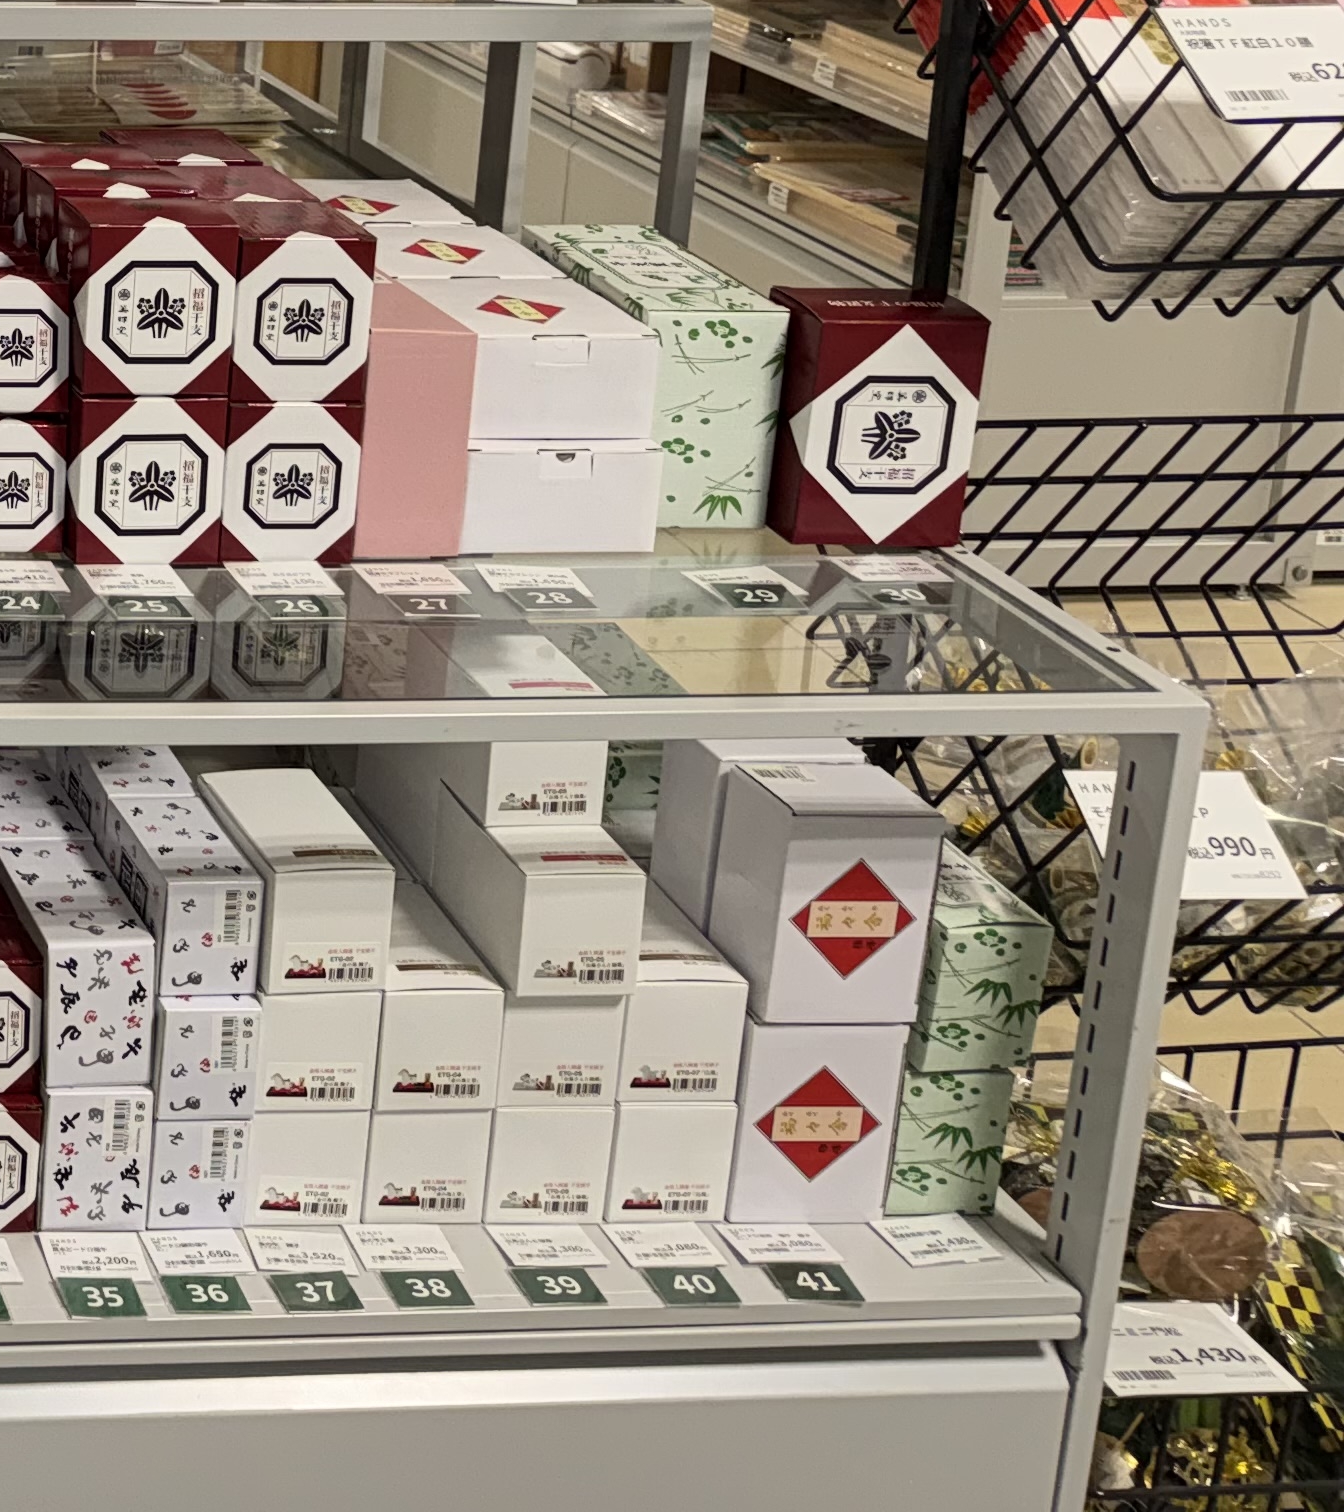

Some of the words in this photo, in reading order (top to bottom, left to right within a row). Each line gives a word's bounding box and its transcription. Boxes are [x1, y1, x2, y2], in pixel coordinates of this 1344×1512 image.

[1173, 19, 1231, 27] HANDS
[527, 591, 573, 605] 28
[734, 589, 778, 603] 29
[124, 599, 167, 613] 25
[275, 600, 319, 614] 26
[409, 597, 448, 611] 27
[411, 1277, 452, 1299] 38
[796, 1271, 841, 1292] 41
[82, 1286, 124, 1307] 35
[186, 1284, 228, 1303] 36
[299, 1281, 338, 1303] 37
